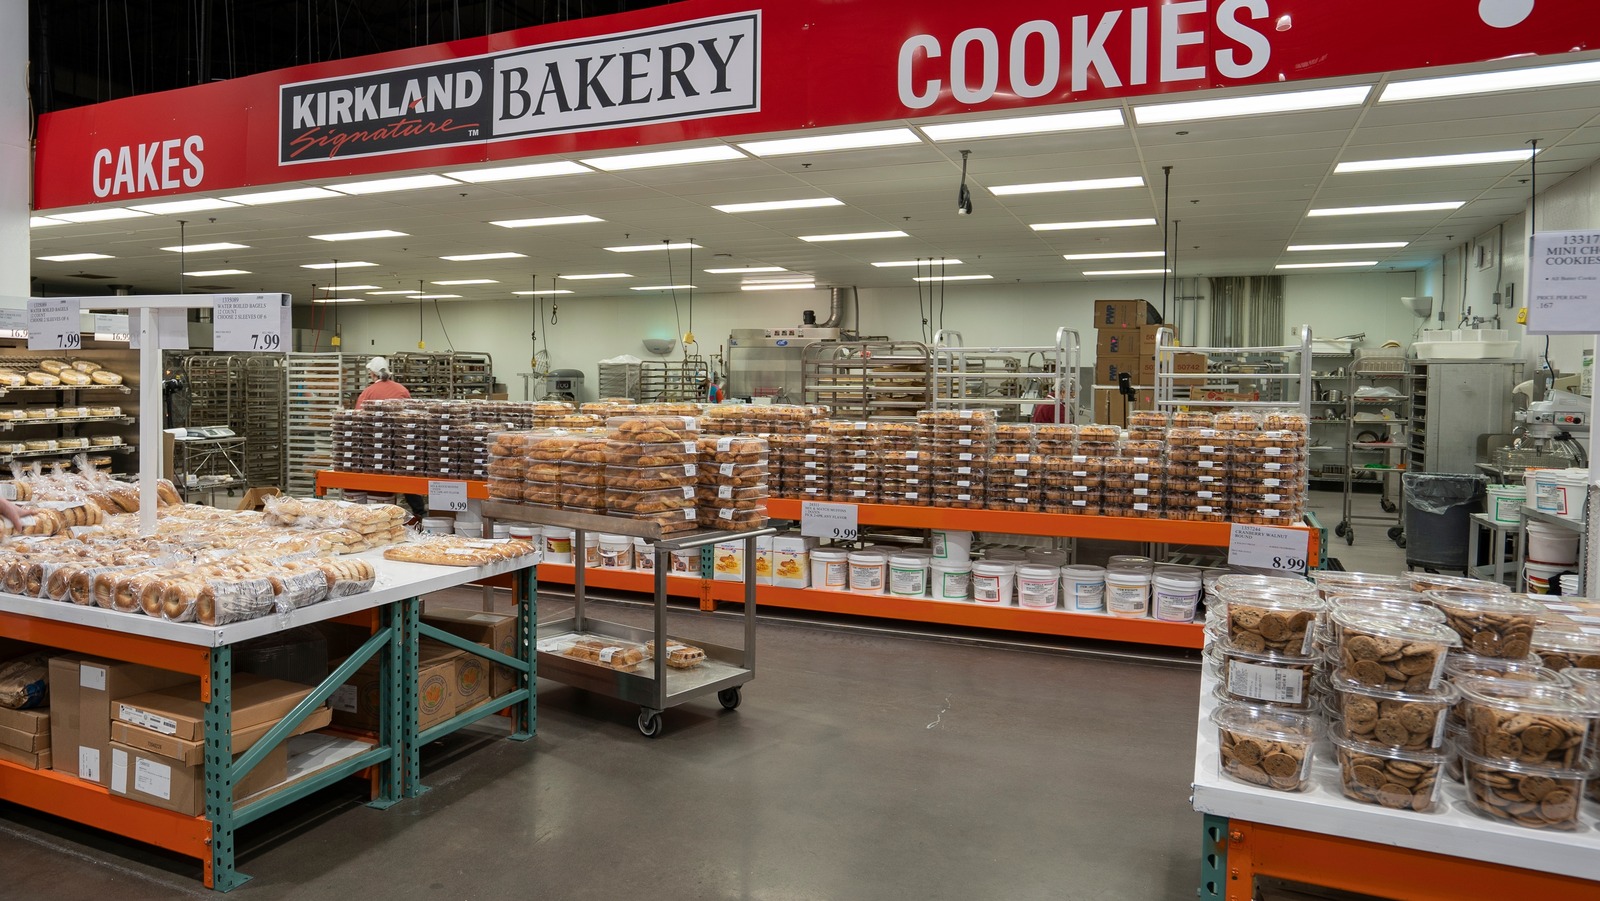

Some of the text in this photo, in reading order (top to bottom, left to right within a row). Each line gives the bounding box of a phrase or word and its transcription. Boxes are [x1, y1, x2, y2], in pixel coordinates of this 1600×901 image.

[897, 0, 1271, 109] COOKIES
[499, 33, 745, 121] BAKERY
[292, 70, 483, 130] KIRKLAND
[290, 117, 480, 159] Signature
[468, 129, 479, 137] TM
[92, 135, 205, 198] CAKES
[1546, 246, 1577, 256] MINI
[1545, 256, 1600, 266] COOKIES
[1105, 304, 1116, 325] PWP
[11, 329, 28, 338] 16.9
[57, 333, 80, 348] 7.99
[251, 333, 280, 350] 7.99
[450, 501, 467, 511] 9.99
[833, 527, 857, 539] 9.99
[1234, 530, 1265, 538] CRANBERRY
[1272, 556, 1306, 571] 8.99
